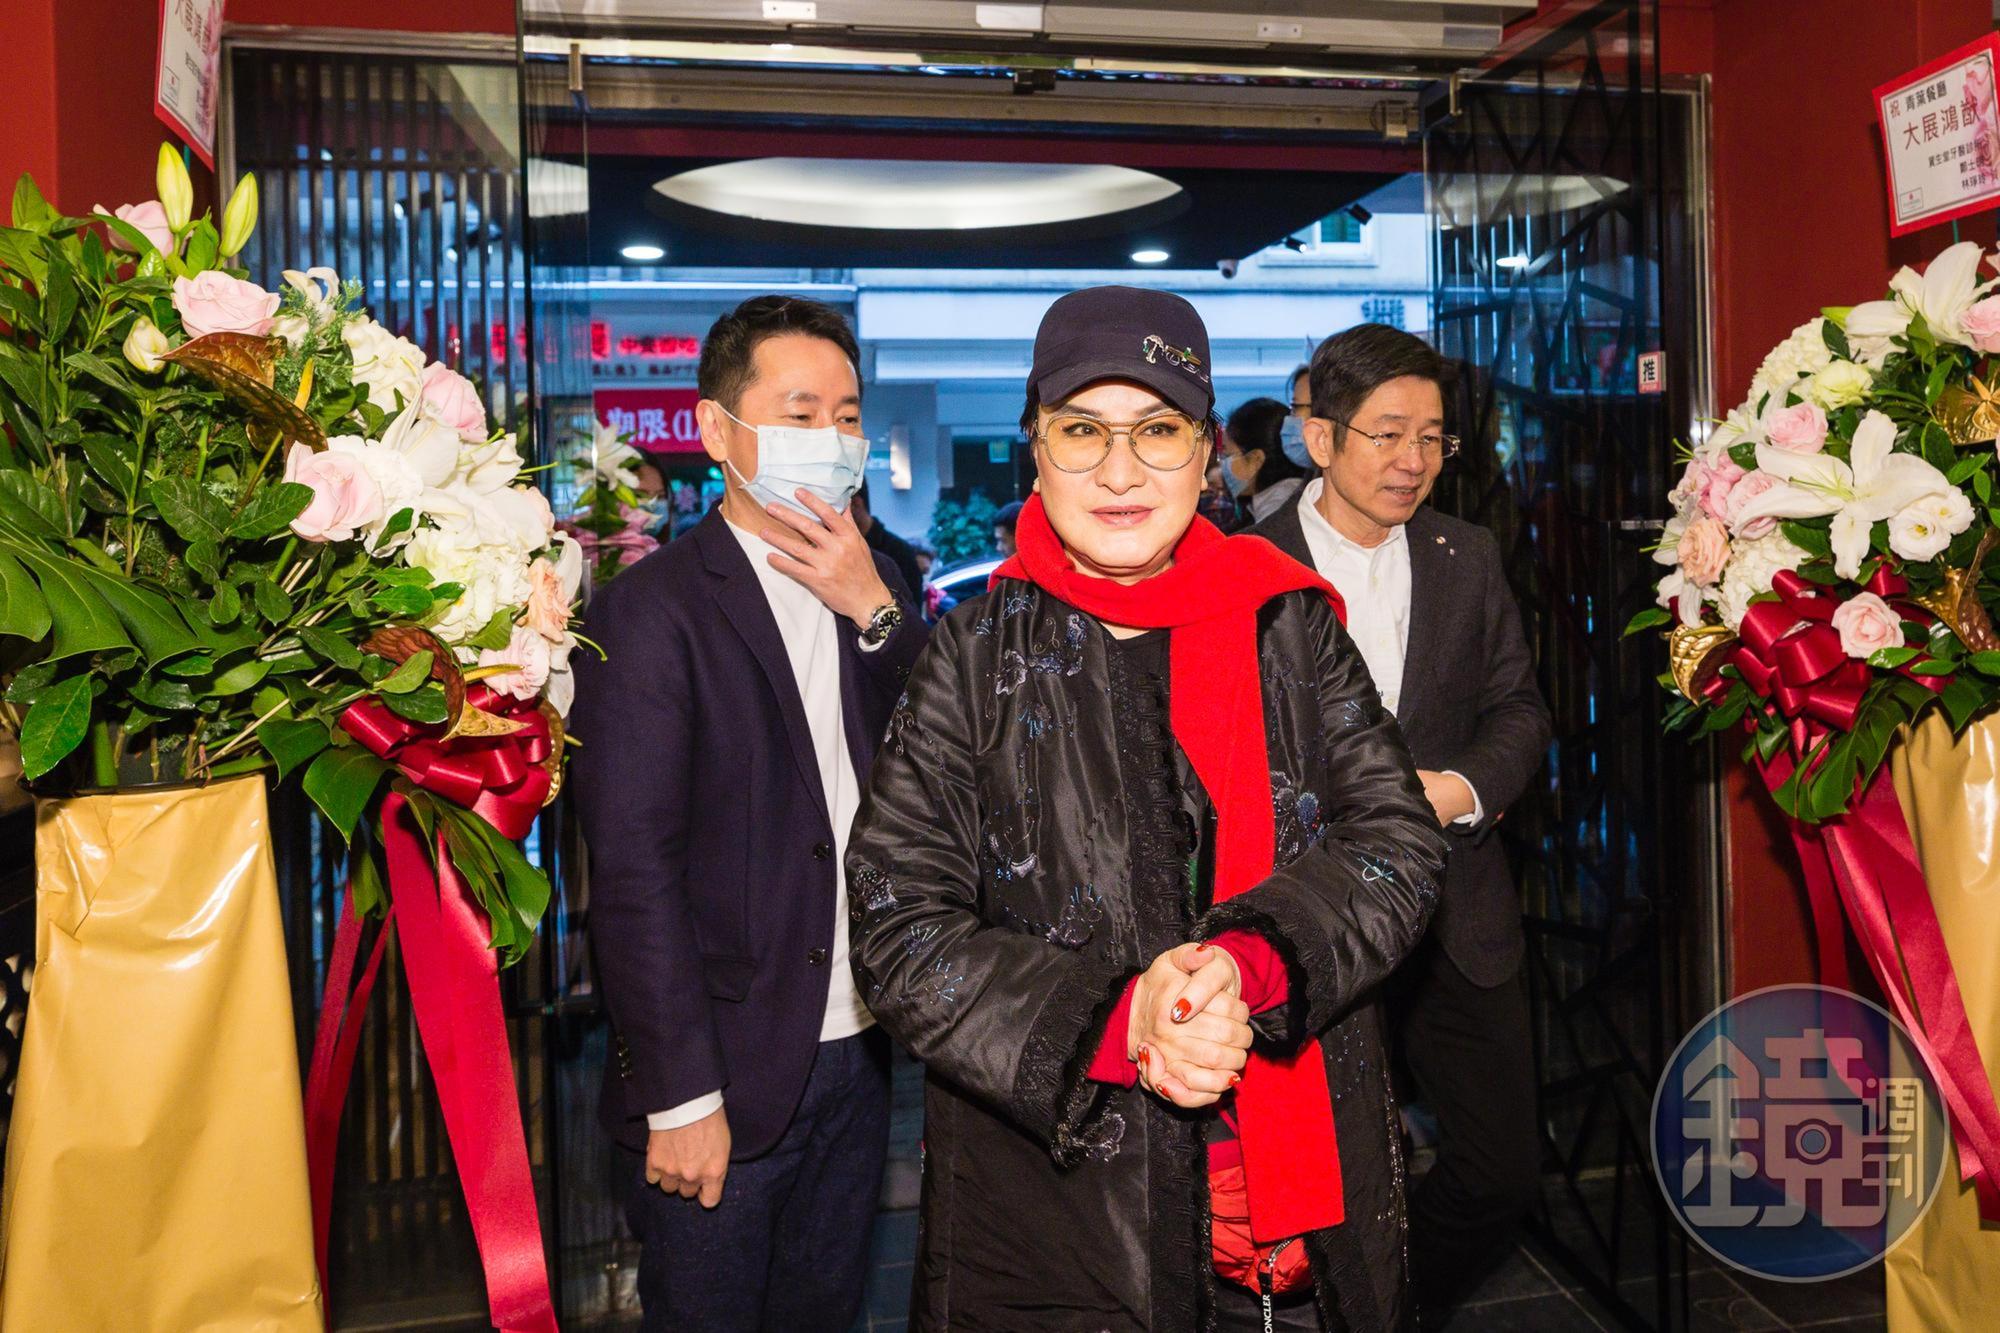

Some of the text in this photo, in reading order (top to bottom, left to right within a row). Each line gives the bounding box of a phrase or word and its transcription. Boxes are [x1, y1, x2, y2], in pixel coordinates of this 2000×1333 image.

[1889, 81, 1947, 118] 祝 青葉餐廳
[1642, 358, 1656, 383] 推
